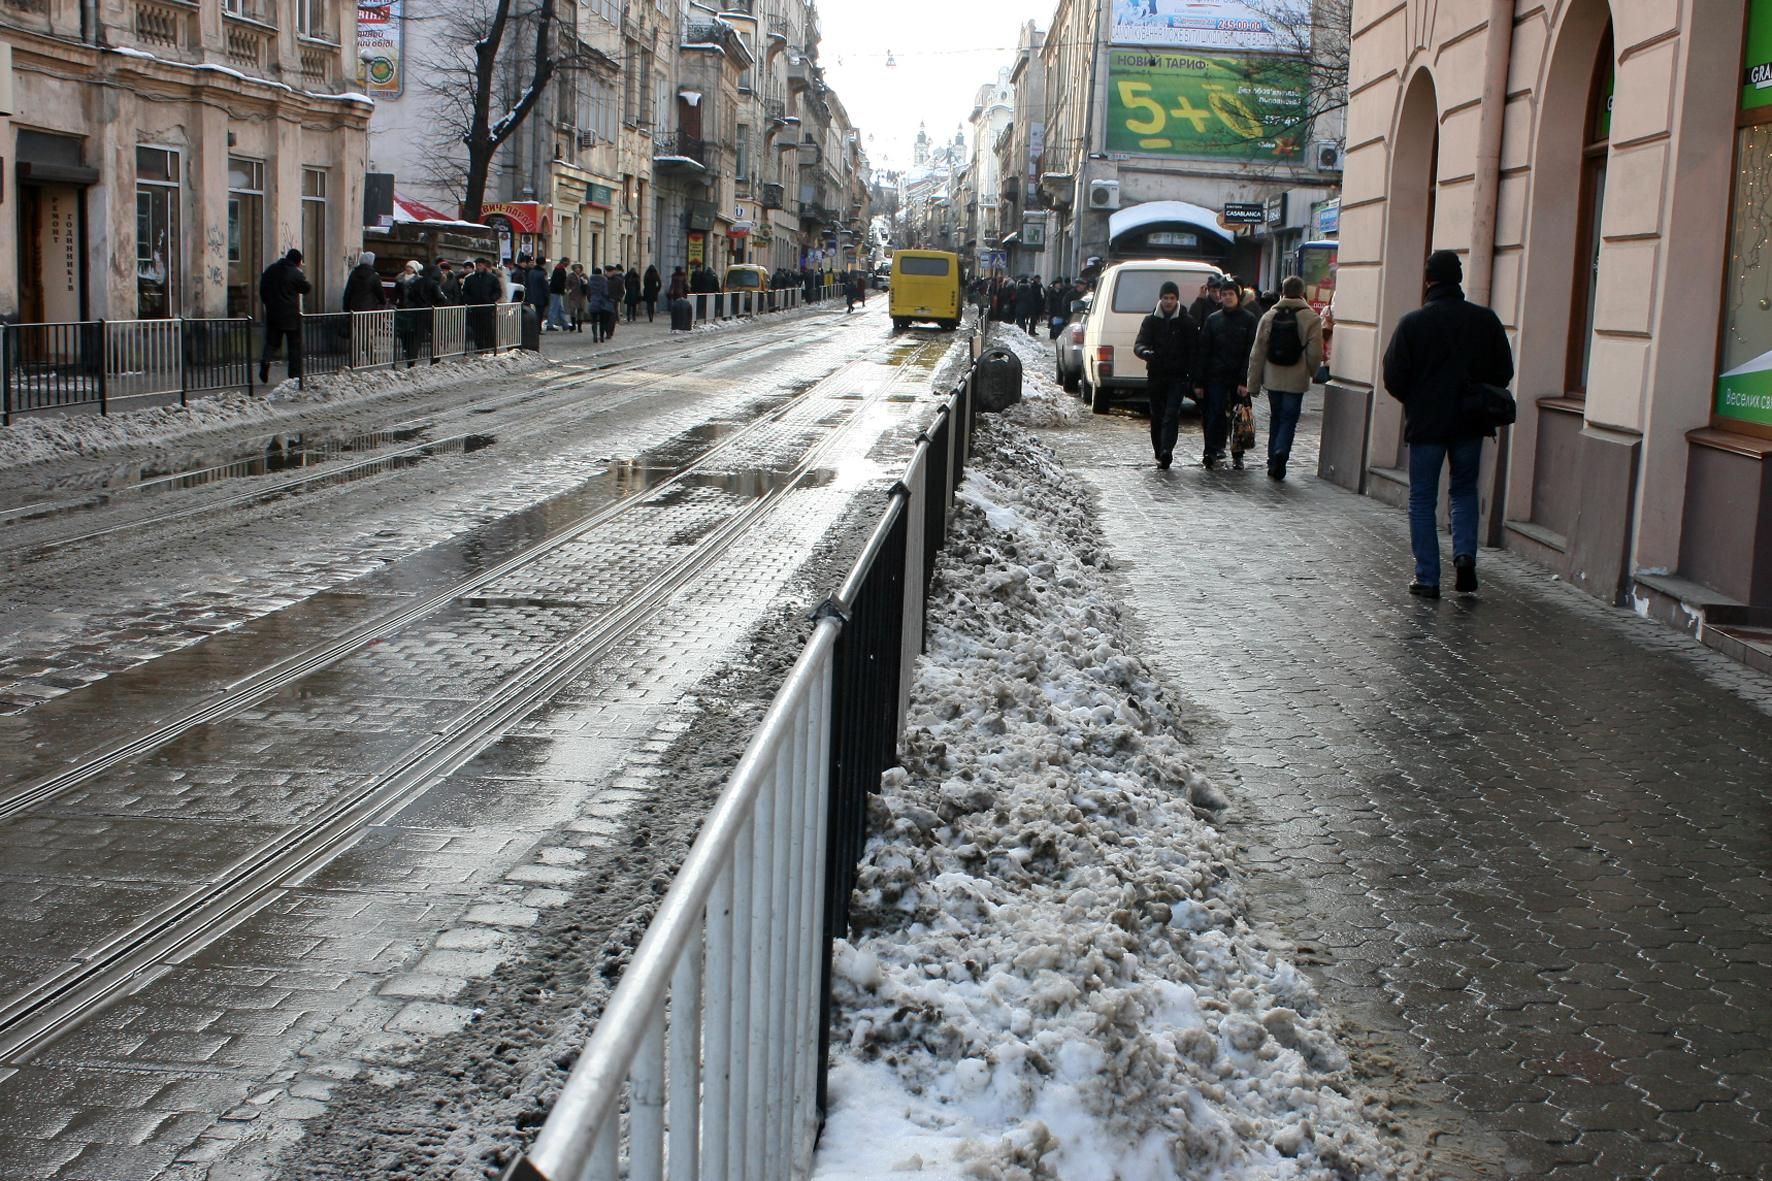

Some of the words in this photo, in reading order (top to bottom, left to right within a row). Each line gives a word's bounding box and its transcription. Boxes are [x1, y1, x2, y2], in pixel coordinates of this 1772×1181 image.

[1117, 54, 1162, 69] НОВИЙ
[1166, 58, 1209, 70] ТАРИФ:
[1751, 65, 1772, 83] GRA
[52, 196, 60, 244] РЕМОНТ
[480, 203, 536, 231] ВИЧ-ПАРАД
[1225, 210, 1262, 218] CASABLANCA
[65, 213, 74, 292] ГОДИННИКІВ
[1760, 395, 1772, 410] св
